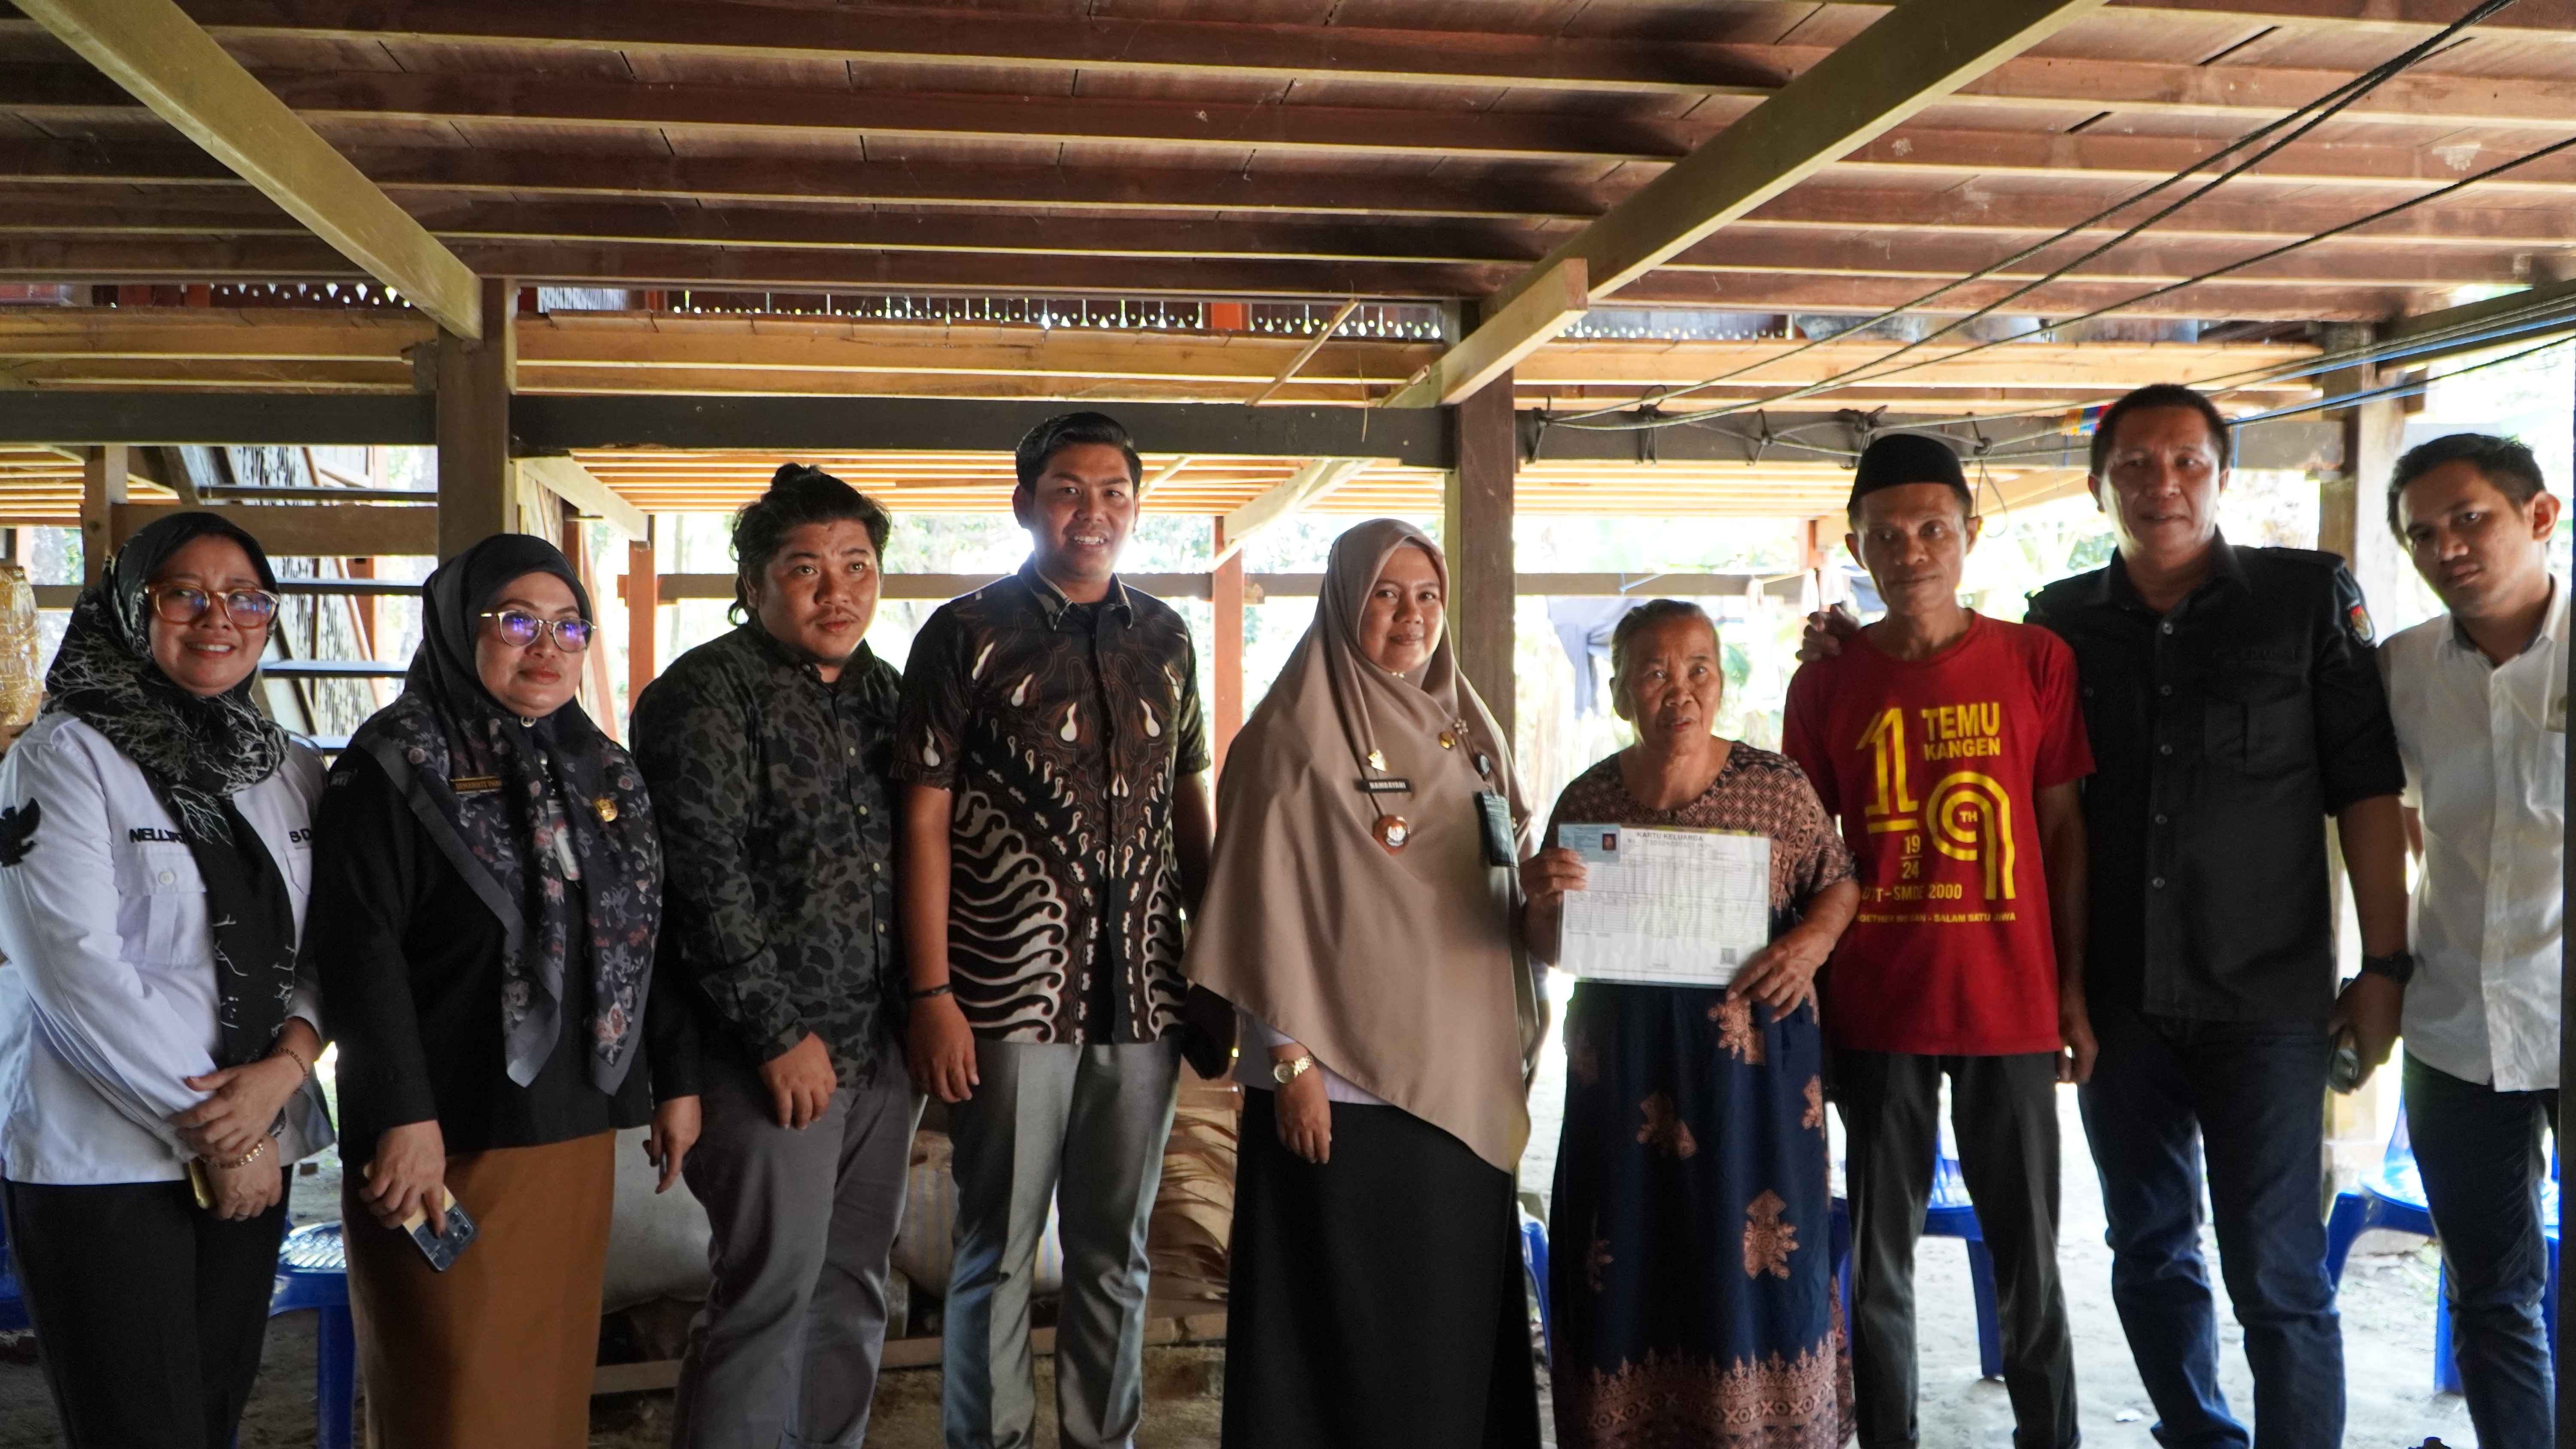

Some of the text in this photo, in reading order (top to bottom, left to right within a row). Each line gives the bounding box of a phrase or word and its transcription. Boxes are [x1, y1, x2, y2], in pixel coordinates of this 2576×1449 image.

[1921, 702, 2000, 741] TEMU
[1924, 737, 2001, 761] KANGEN
[1959, 810, 1978, 823] TH
[1664, 833, 1704, 841] KELUARGA
[1904, 835, 1921, 854] 19
[1902, 859, 1920, 879] 24
[1928, 883, 1962, 900] 2000
[1934, 913, 1966, 923] SALAM
[1968, 912, 1991, 922] SATU
